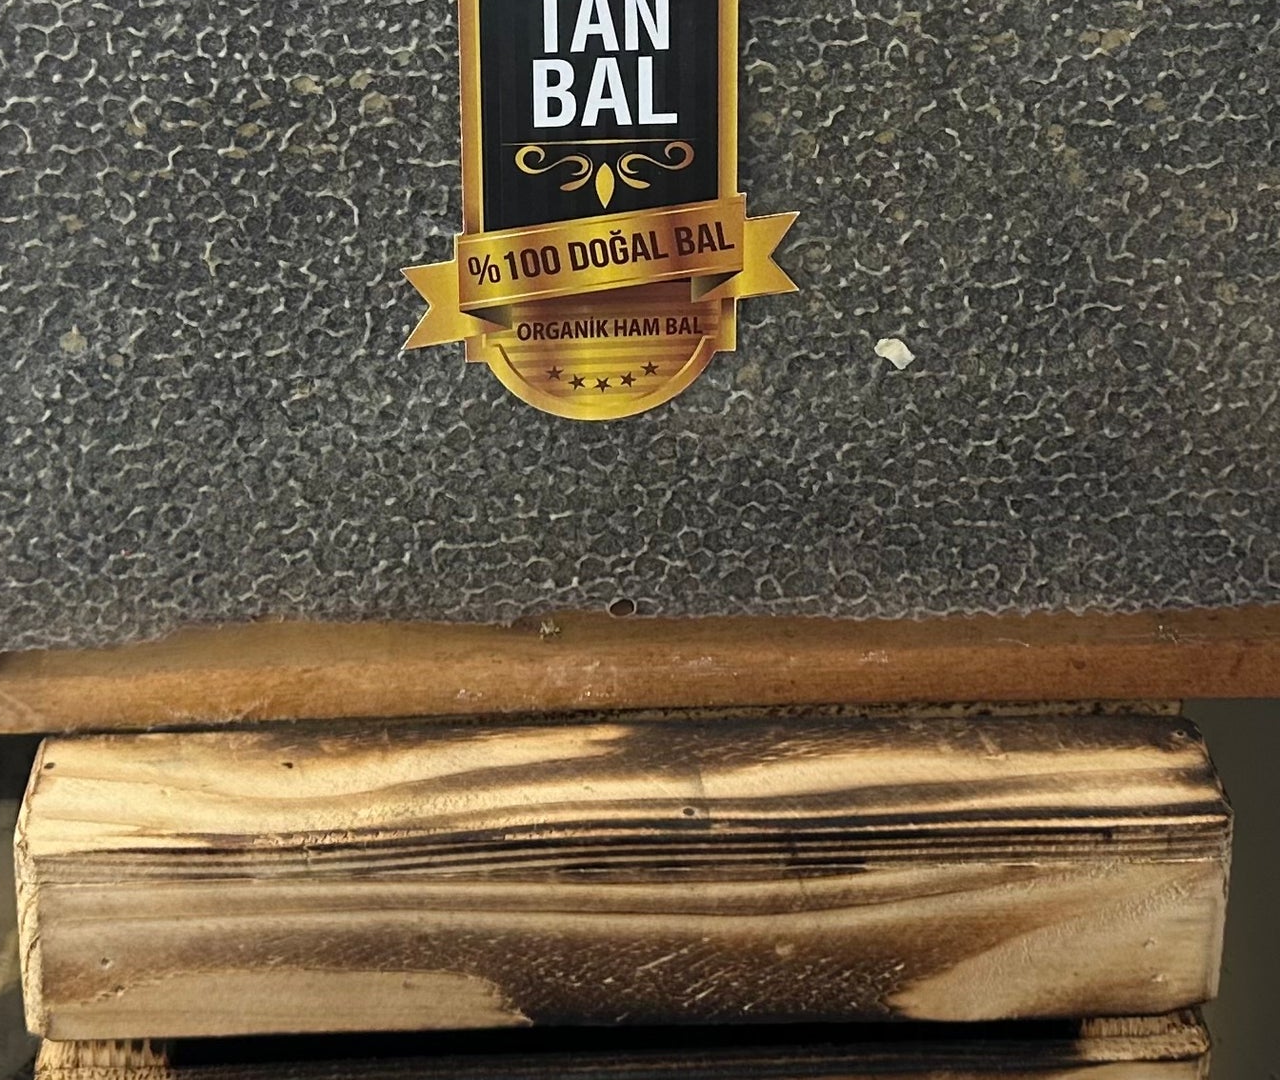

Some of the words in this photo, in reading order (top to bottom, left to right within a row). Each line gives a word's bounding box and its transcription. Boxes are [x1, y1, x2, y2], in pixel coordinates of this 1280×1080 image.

[531, 55, 678, 129] BAL
[467, 243, 562, 287] %100
[568, 228, 669, 272] DOĞAL
[677, 220, 735, 256] BAL
[516, 316, 608, 342] ORGANİK
[613, 317, 661, 338] HAM
[665, 315, 703, 336] BAL
